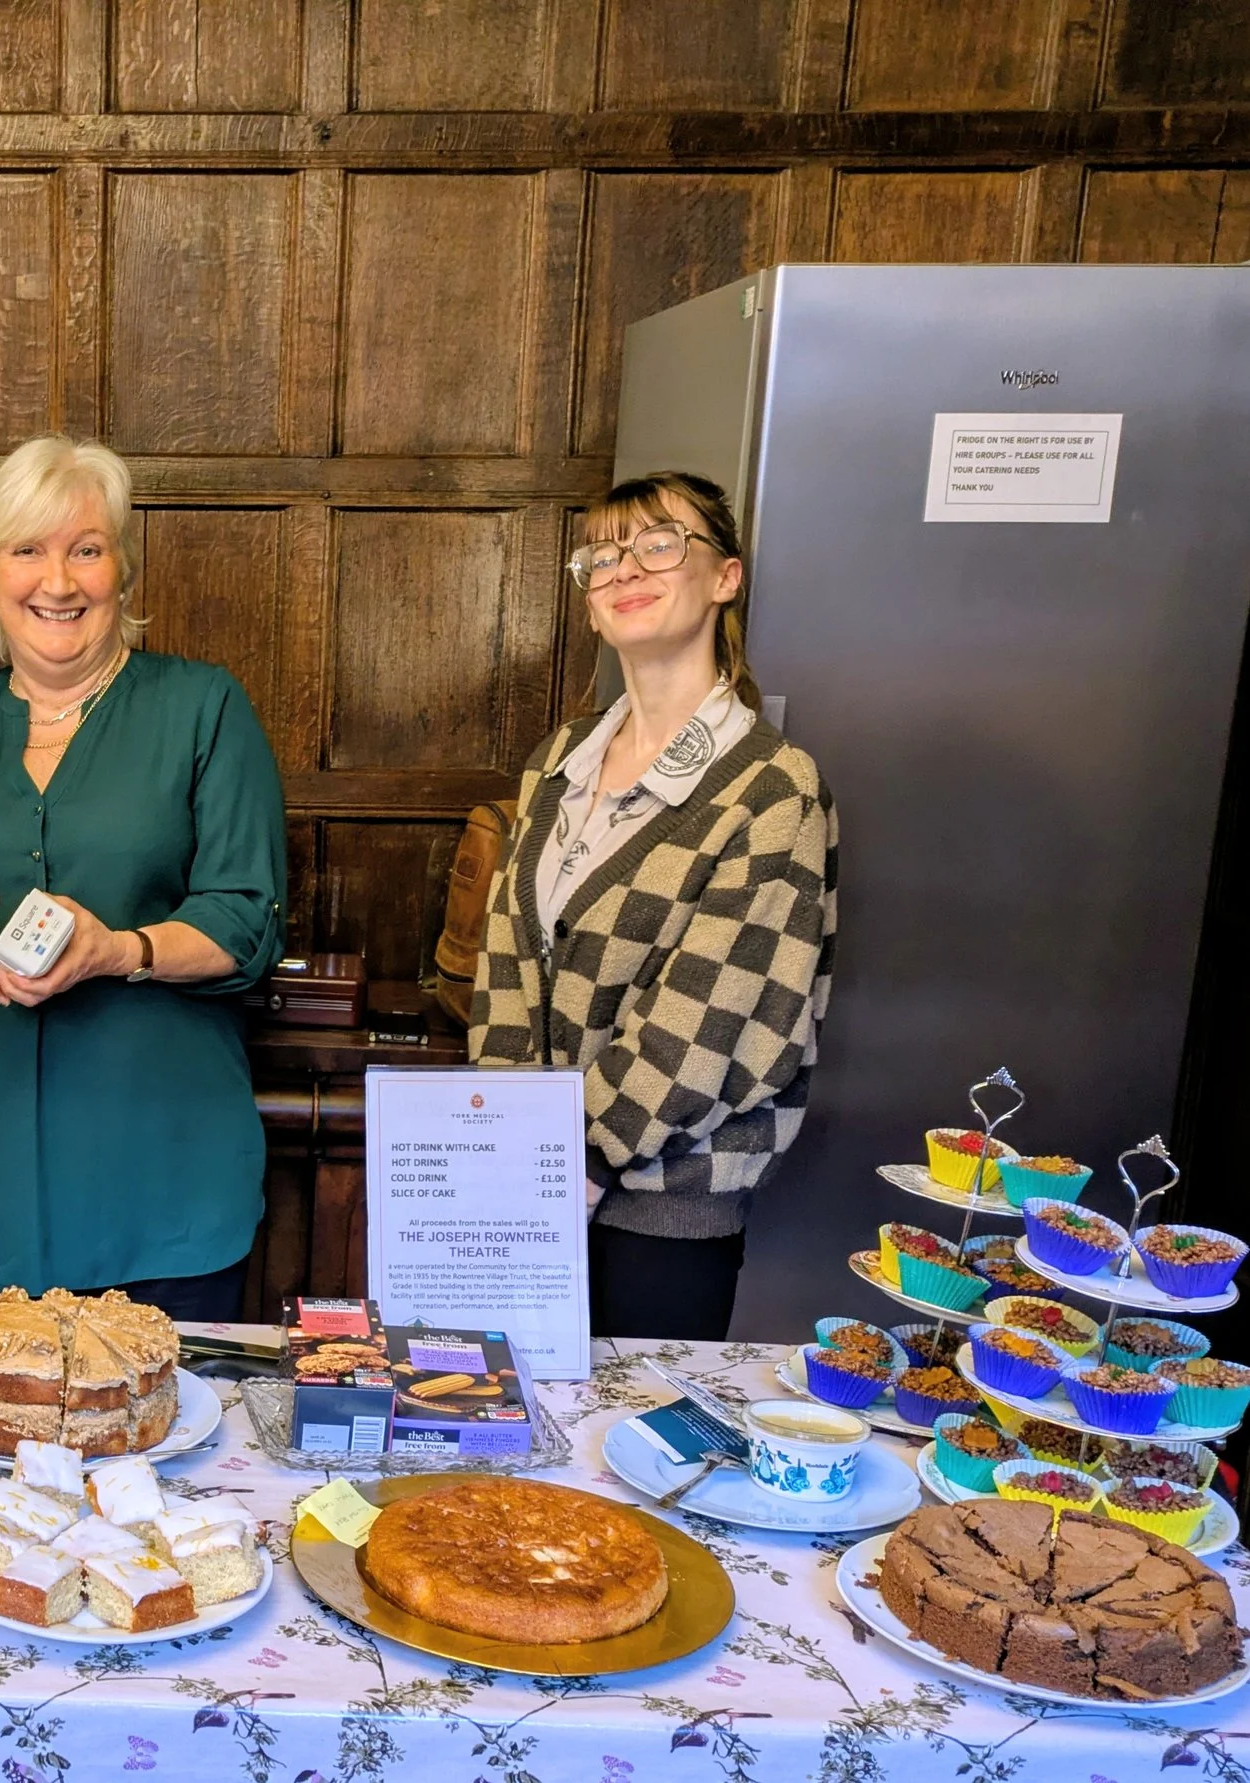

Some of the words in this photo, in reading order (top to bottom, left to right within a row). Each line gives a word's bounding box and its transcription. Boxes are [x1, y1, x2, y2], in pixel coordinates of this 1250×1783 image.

[1001, 371, 1058, 388] Whirlpool
[19, 905, 38, 929] Square
[391, 1143, 410, 1151] HOT
[414, 1143, 442, 1151] DRINK
[445, 1143, 469, 1151] WITH
[540, 1144, 564, 1152] £5.00
[392, 1158, 410, 1166] HOT
[414, 1158, 448, 1166] DRINKS
[540, 1159, 565, 1167] £2.50
[391, 1173, 415, 1181] COLD
[391, 1189, 414, 1197] SLICE
[417, 1189, 429, 1197] OF
[432, 1189, 455, 1197] CAKE
[541, 1190, 566, 1198] £3.00
[399, 1231, 424, 1241] THE
[428, 1231, 479, 1241] JOSEPH
[484, 1232, 559, 1242] ROWNTREE
[449, 1246, 509, 1257] THEATRE
[423, 1333, 440, 1341] the
[441, 1335, 462, 1343] Best
[408, 1431, 424, 1439] the
[424, 1431, 444, 1441] Best
